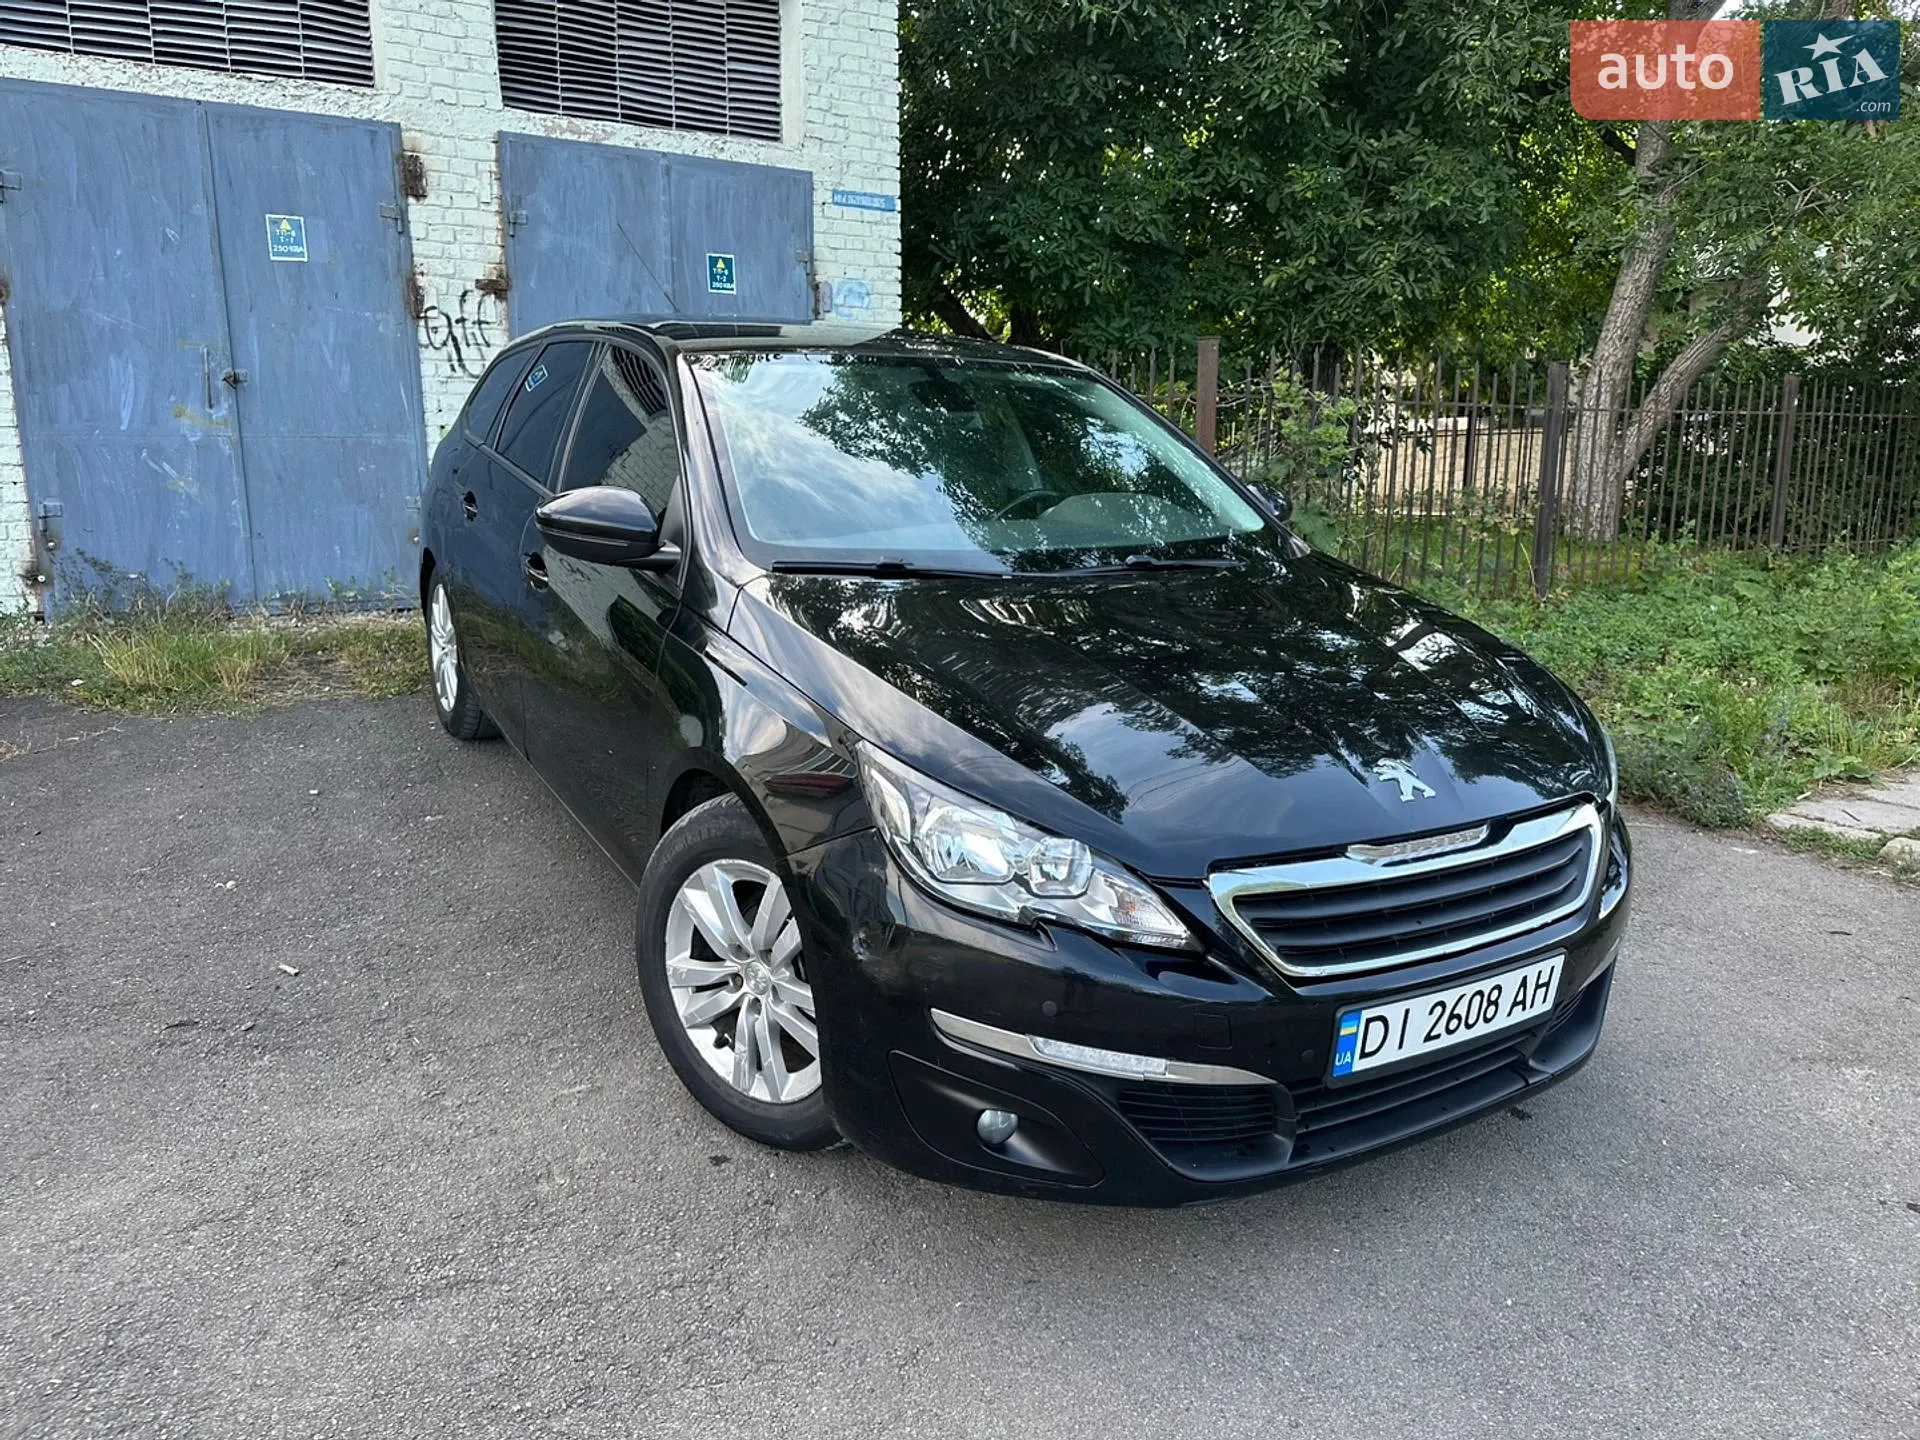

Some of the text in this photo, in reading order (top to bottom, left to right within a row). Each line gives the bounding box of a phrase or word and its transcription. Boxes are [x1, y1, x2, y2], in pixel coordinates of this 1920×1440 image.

[1358, 965, 1556, 1060] DI 2608 AH
[1335, 1052, 1351, 1065] UA
